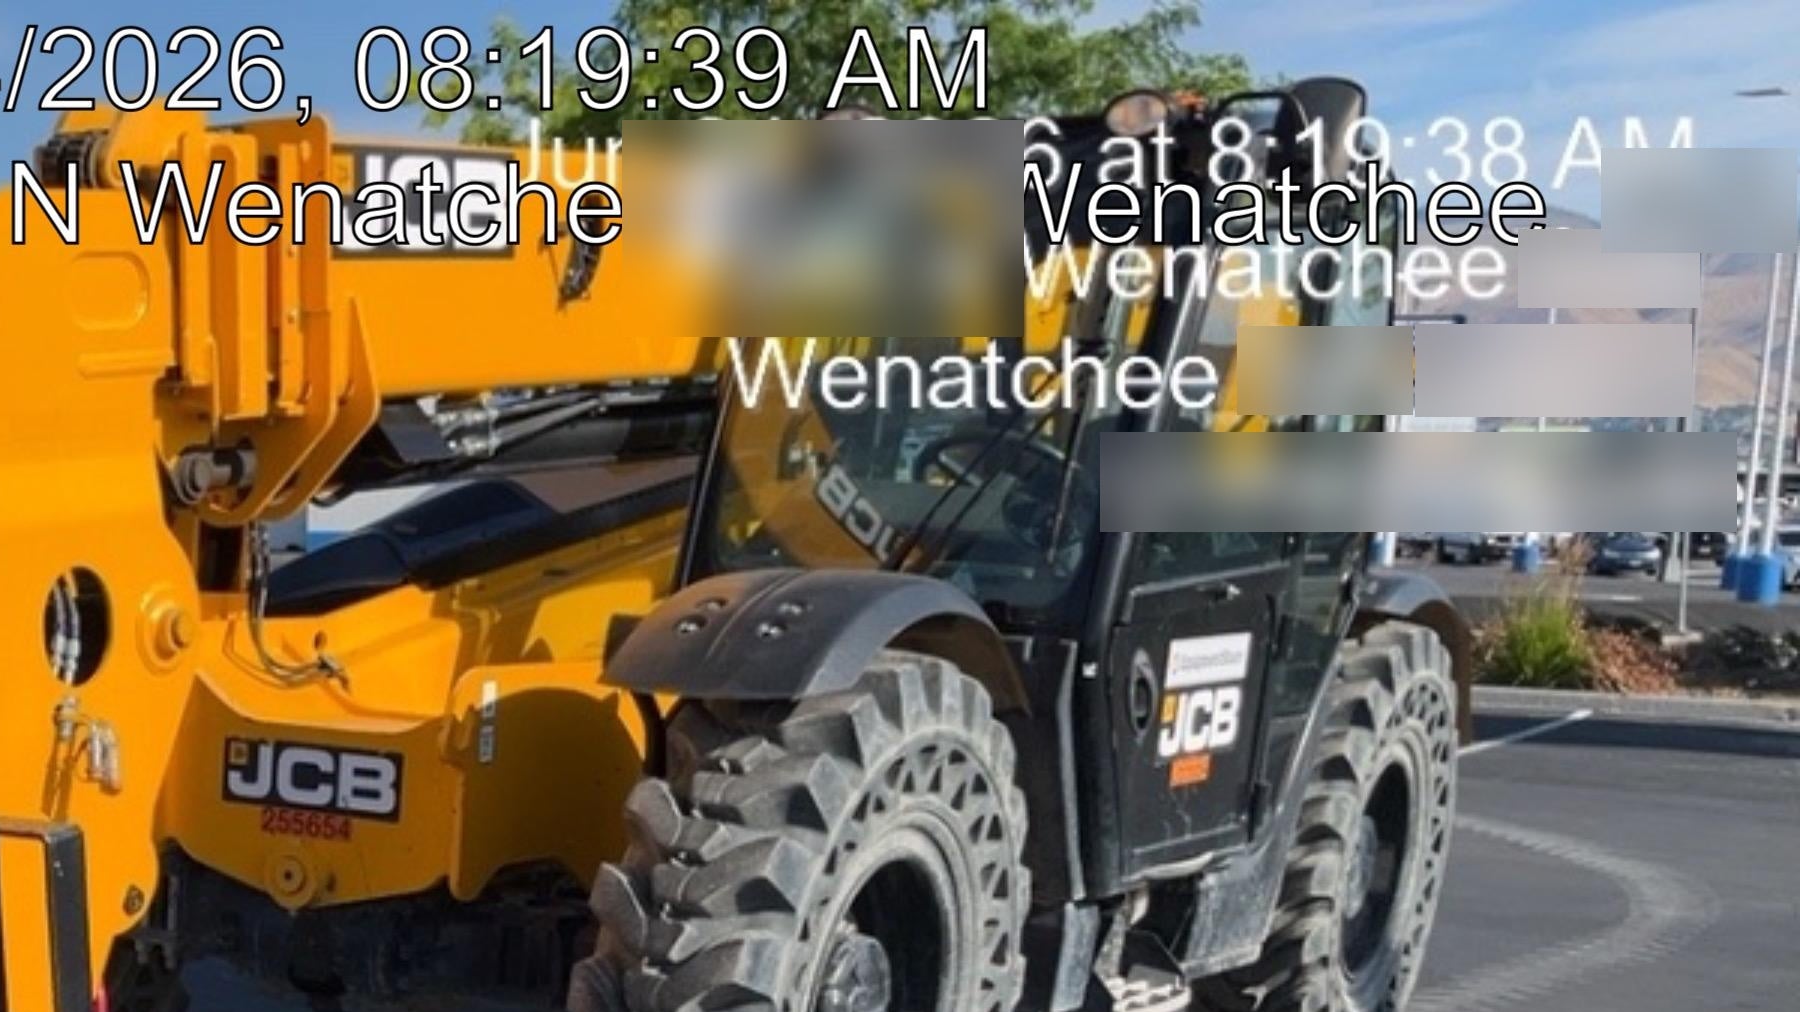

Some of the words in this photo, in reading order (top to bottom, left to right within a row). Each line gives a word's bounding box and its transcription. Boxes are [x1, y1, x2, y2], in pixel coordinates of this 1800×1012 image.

[1158, 686, 1243, 757] JCB
[227, 741, 397, 814] JCB
[261, 808, 351, 839] 255654
